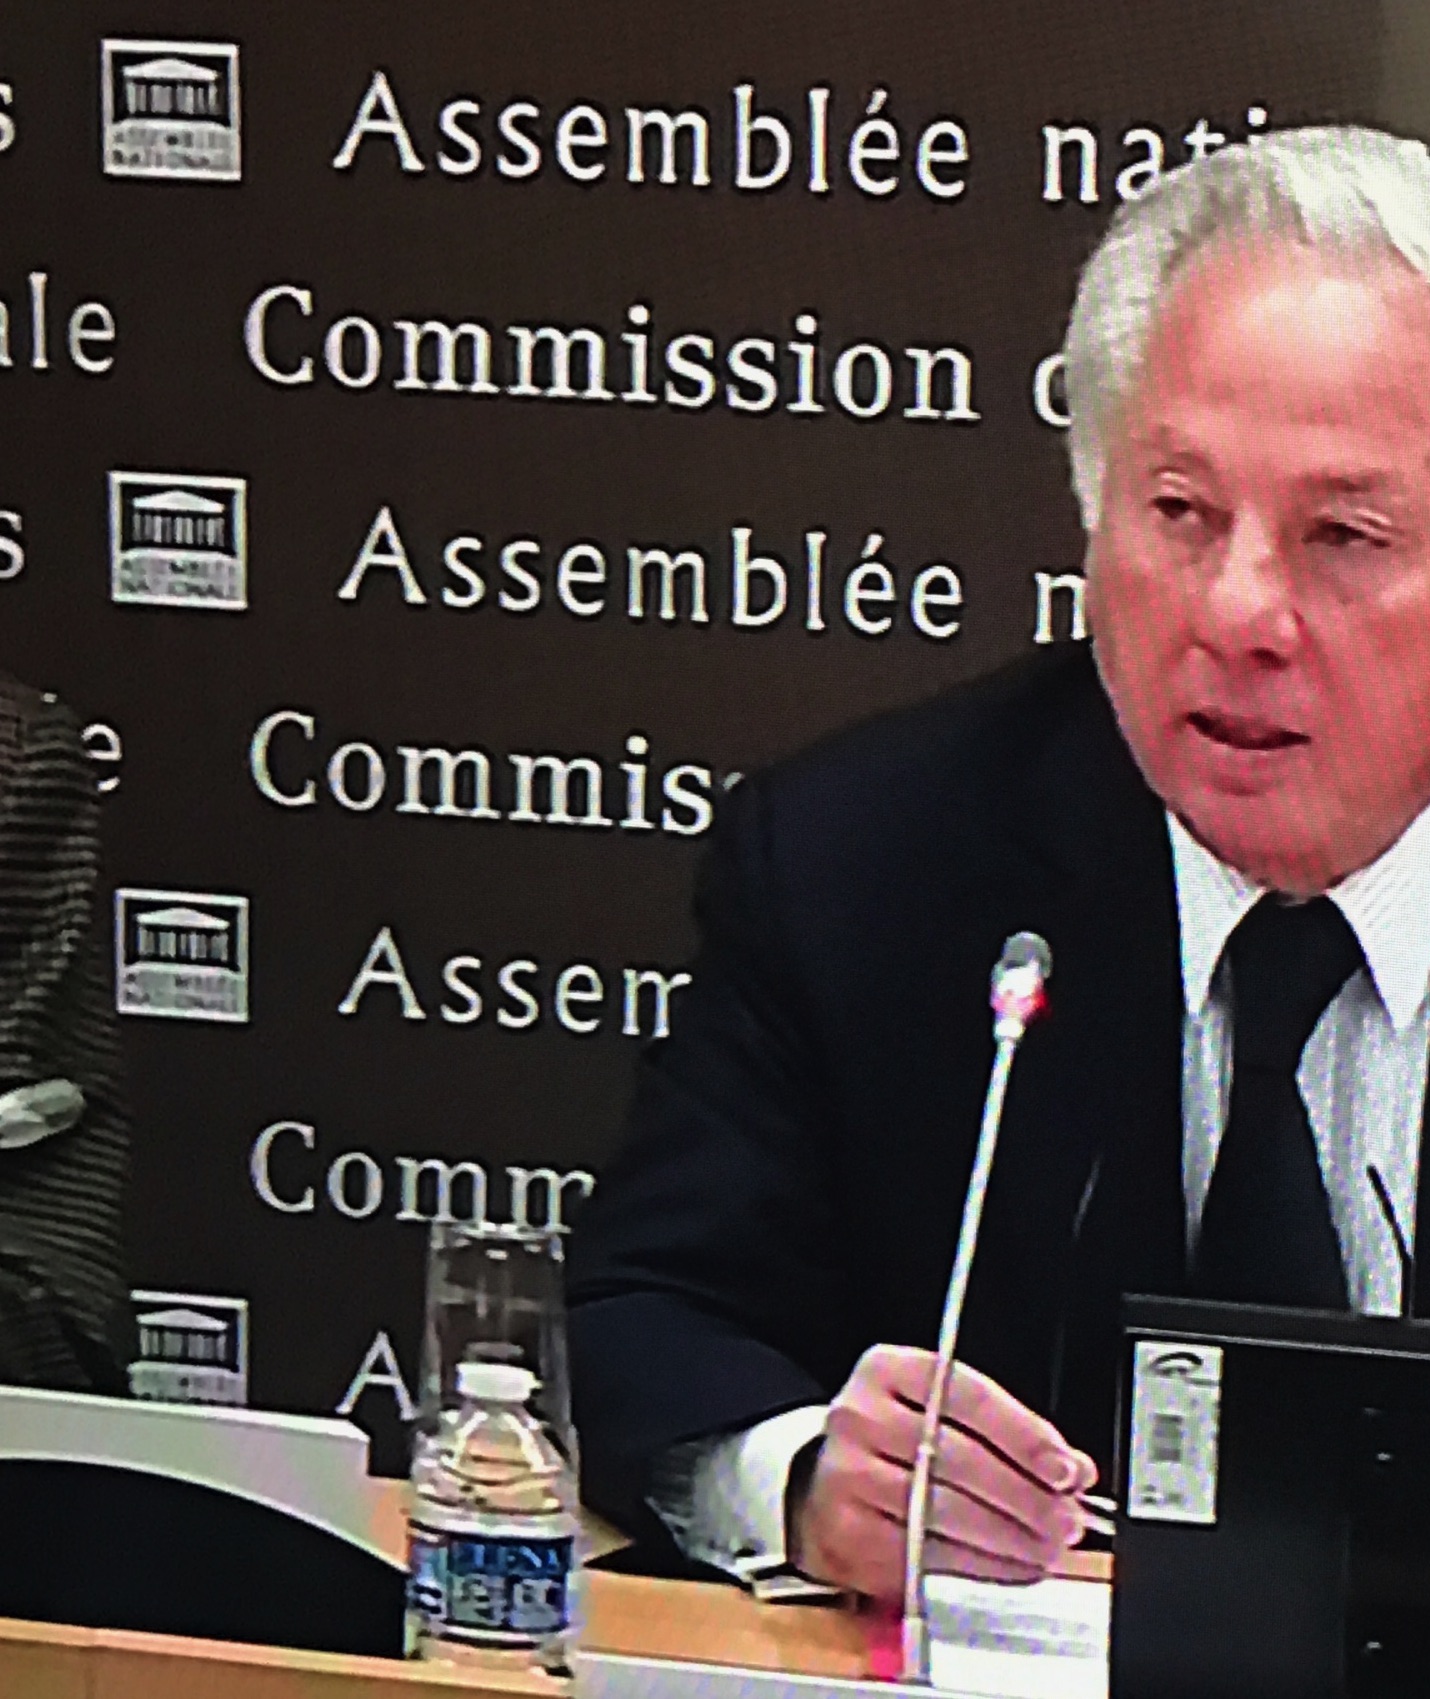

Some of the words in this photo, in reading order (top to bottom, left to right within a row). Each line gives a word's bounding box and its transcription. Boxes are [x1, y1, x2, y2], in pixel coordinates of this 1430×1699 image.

[333, 72, 969, 196] Assemblée
[246, 285, 981, 420] Commission
[338, 506, 963, 638] Assemblée
[251, 711, 742, 835] Commis
